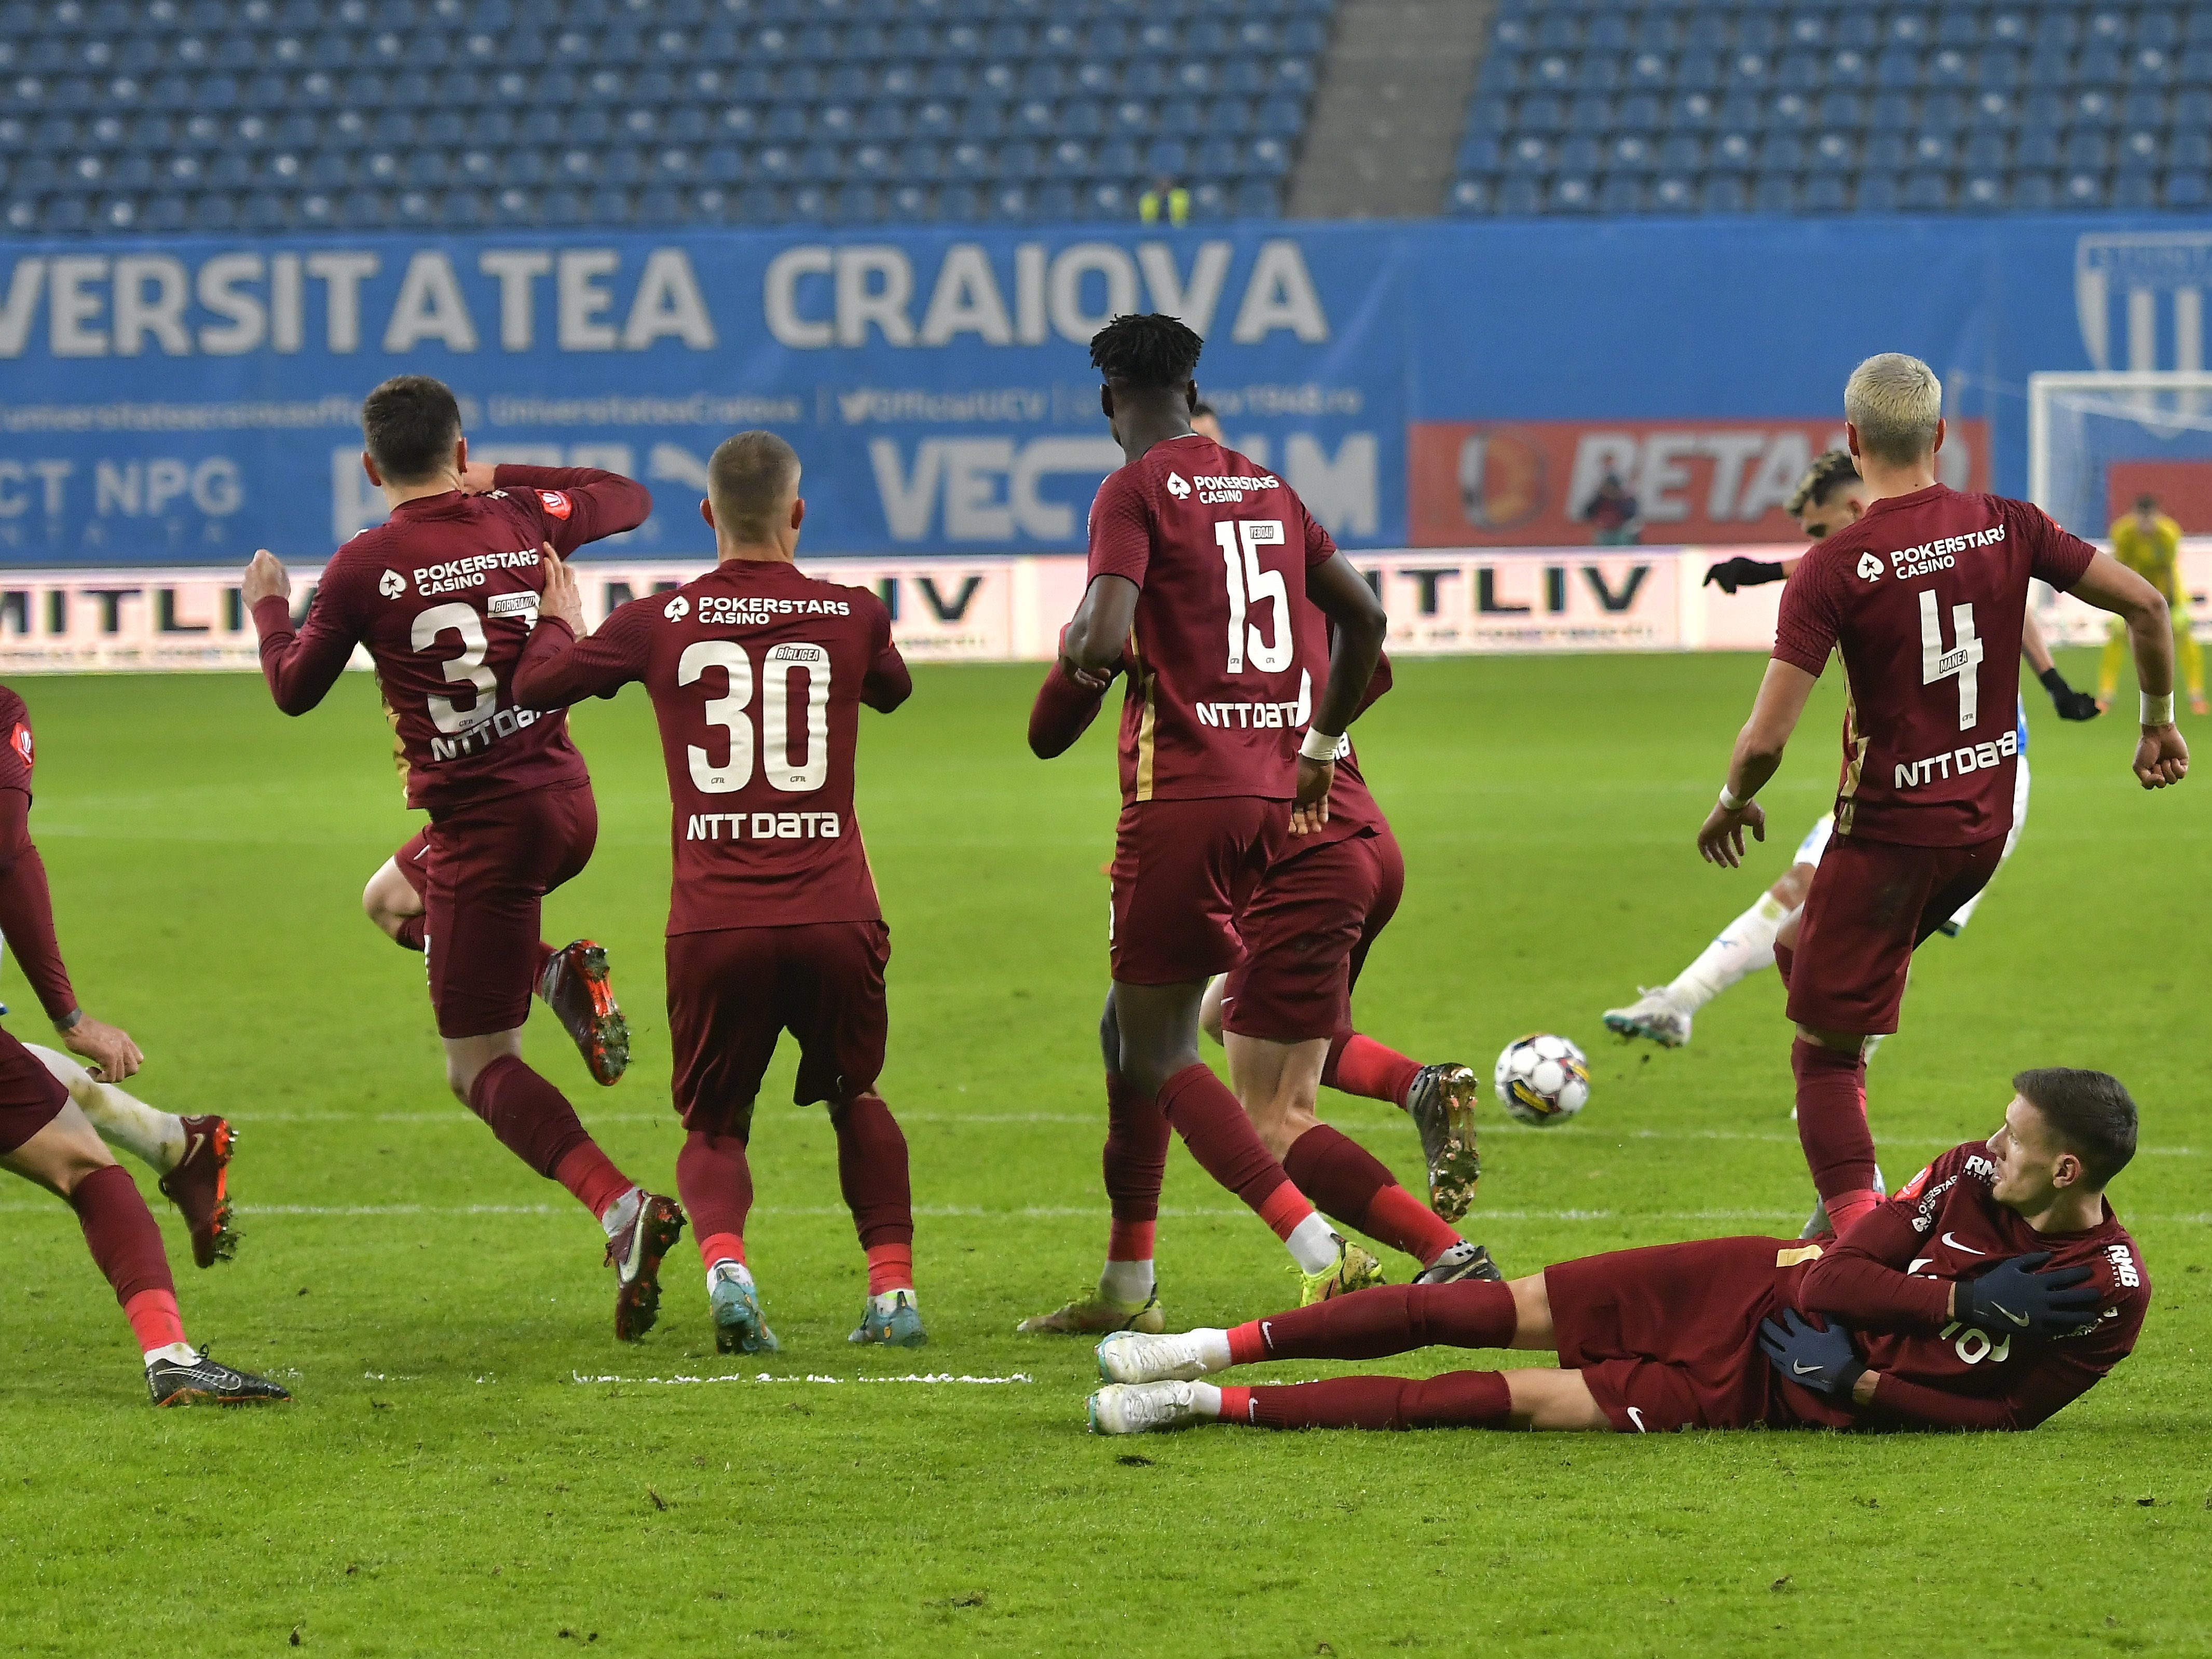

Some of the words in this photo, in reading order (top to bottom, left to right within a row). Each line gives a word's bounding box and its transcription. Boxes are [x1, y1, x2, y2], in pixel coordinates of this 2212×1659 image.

[762, 241, 1330, 349] CRAIOVA
[94, 456, 245, 519] NPG
[1193, 475, 1280, 491] POKERSTARS
[1563, 432, 1970, 523] BETA
[1199, 489, 1243, 504] CASINO
[1250, 527, 1273, 538] YEBOAH
[1890, 524, 2005, 567] POKERSTARS
[413, 549, 540, 585] POKERSTARS
[1896, 555, 1955, 580] CASINO
[418, 572, 487, 596] CASINO
[1214, 519, 1294, 674] 15
[699, 597, 851, 616] POKERSTARS
[699, 611, 770, 625] CASINO
[1919, 589, 1984, 732] 4
[1939, 650, 1968, 673] MANEA
[678, 640, 831, 793] 30
[1195, 702, 1252, 728] NTT
[431, 720, 491, 762] NTT
[1895, 752, 1952, 789] NTT
[686, 814, 746, 841] NTT
[1964, 1155, 1995, 1176] RM
[2108, 1245, 2139, 1287] RMB
